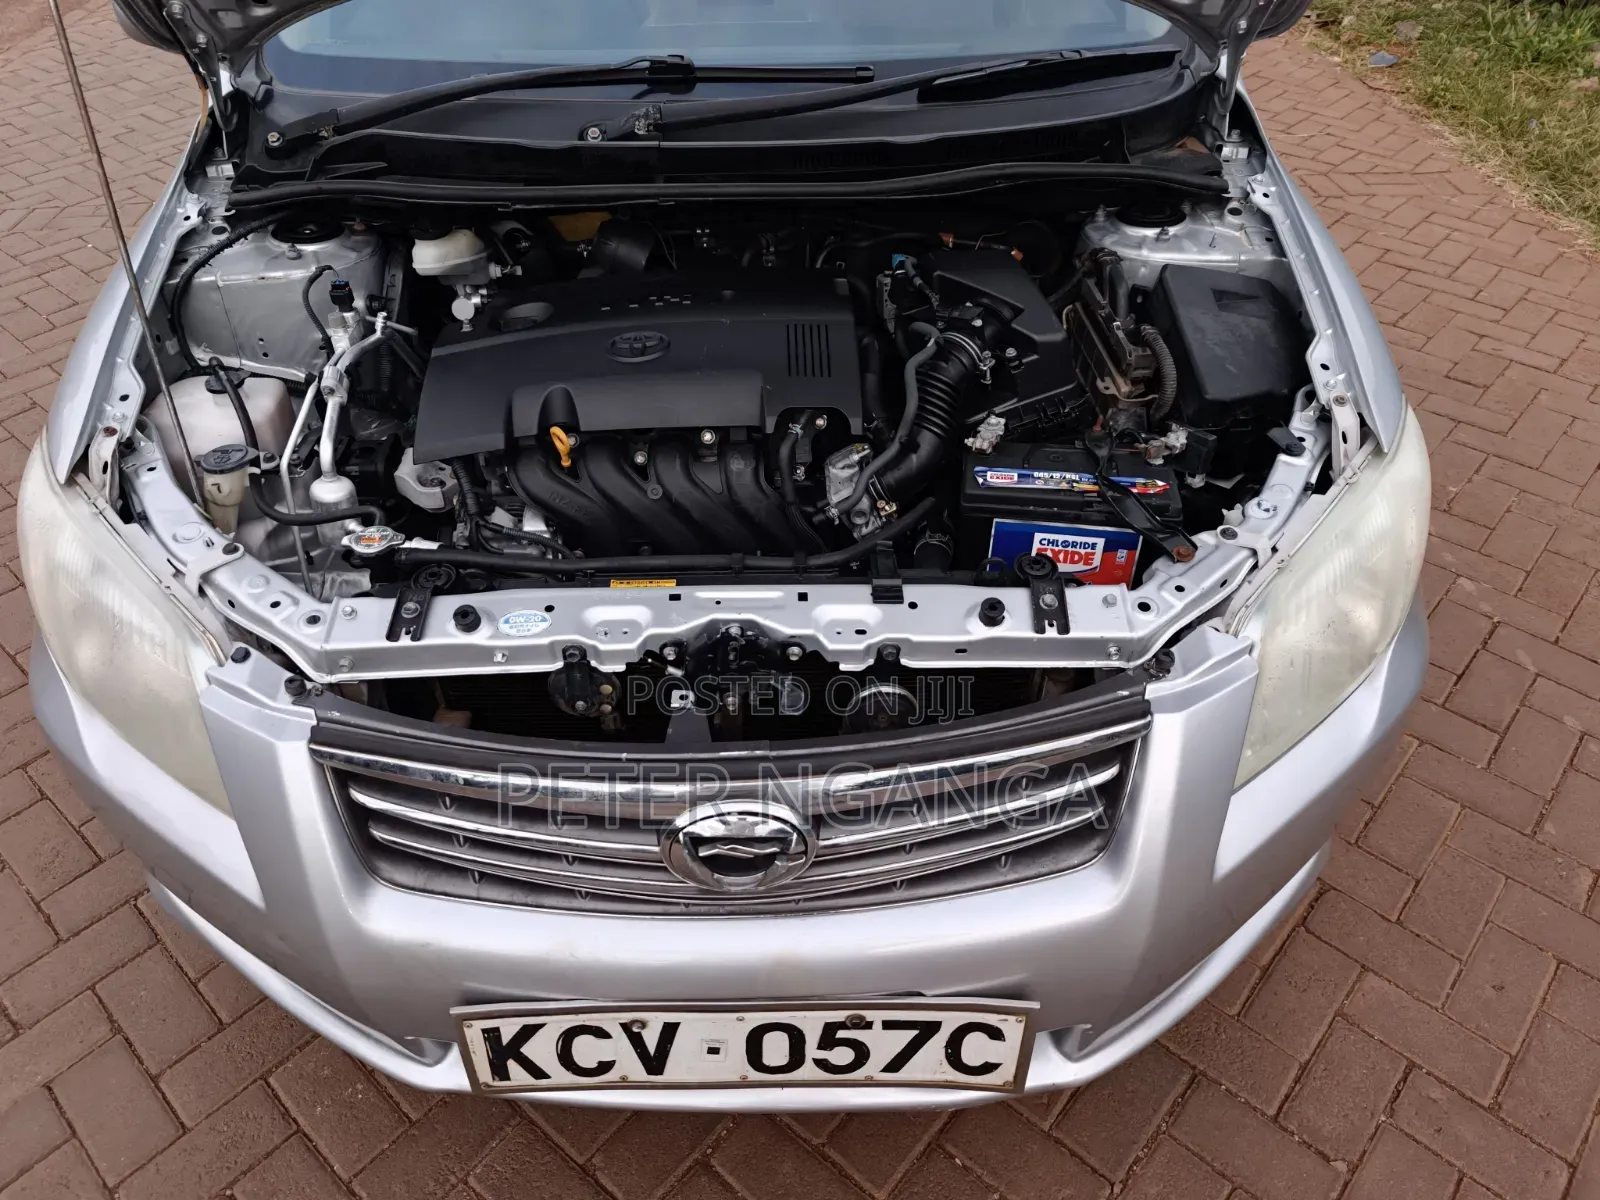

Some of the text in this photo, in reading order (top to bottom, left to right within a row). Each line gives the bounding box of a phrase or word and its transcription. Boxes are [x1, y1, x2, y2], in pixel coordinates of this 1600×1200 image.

[1039, 538, 1098, 550] CHLORIDE
[481, 1020, 1007, 1082] KCV 057C
